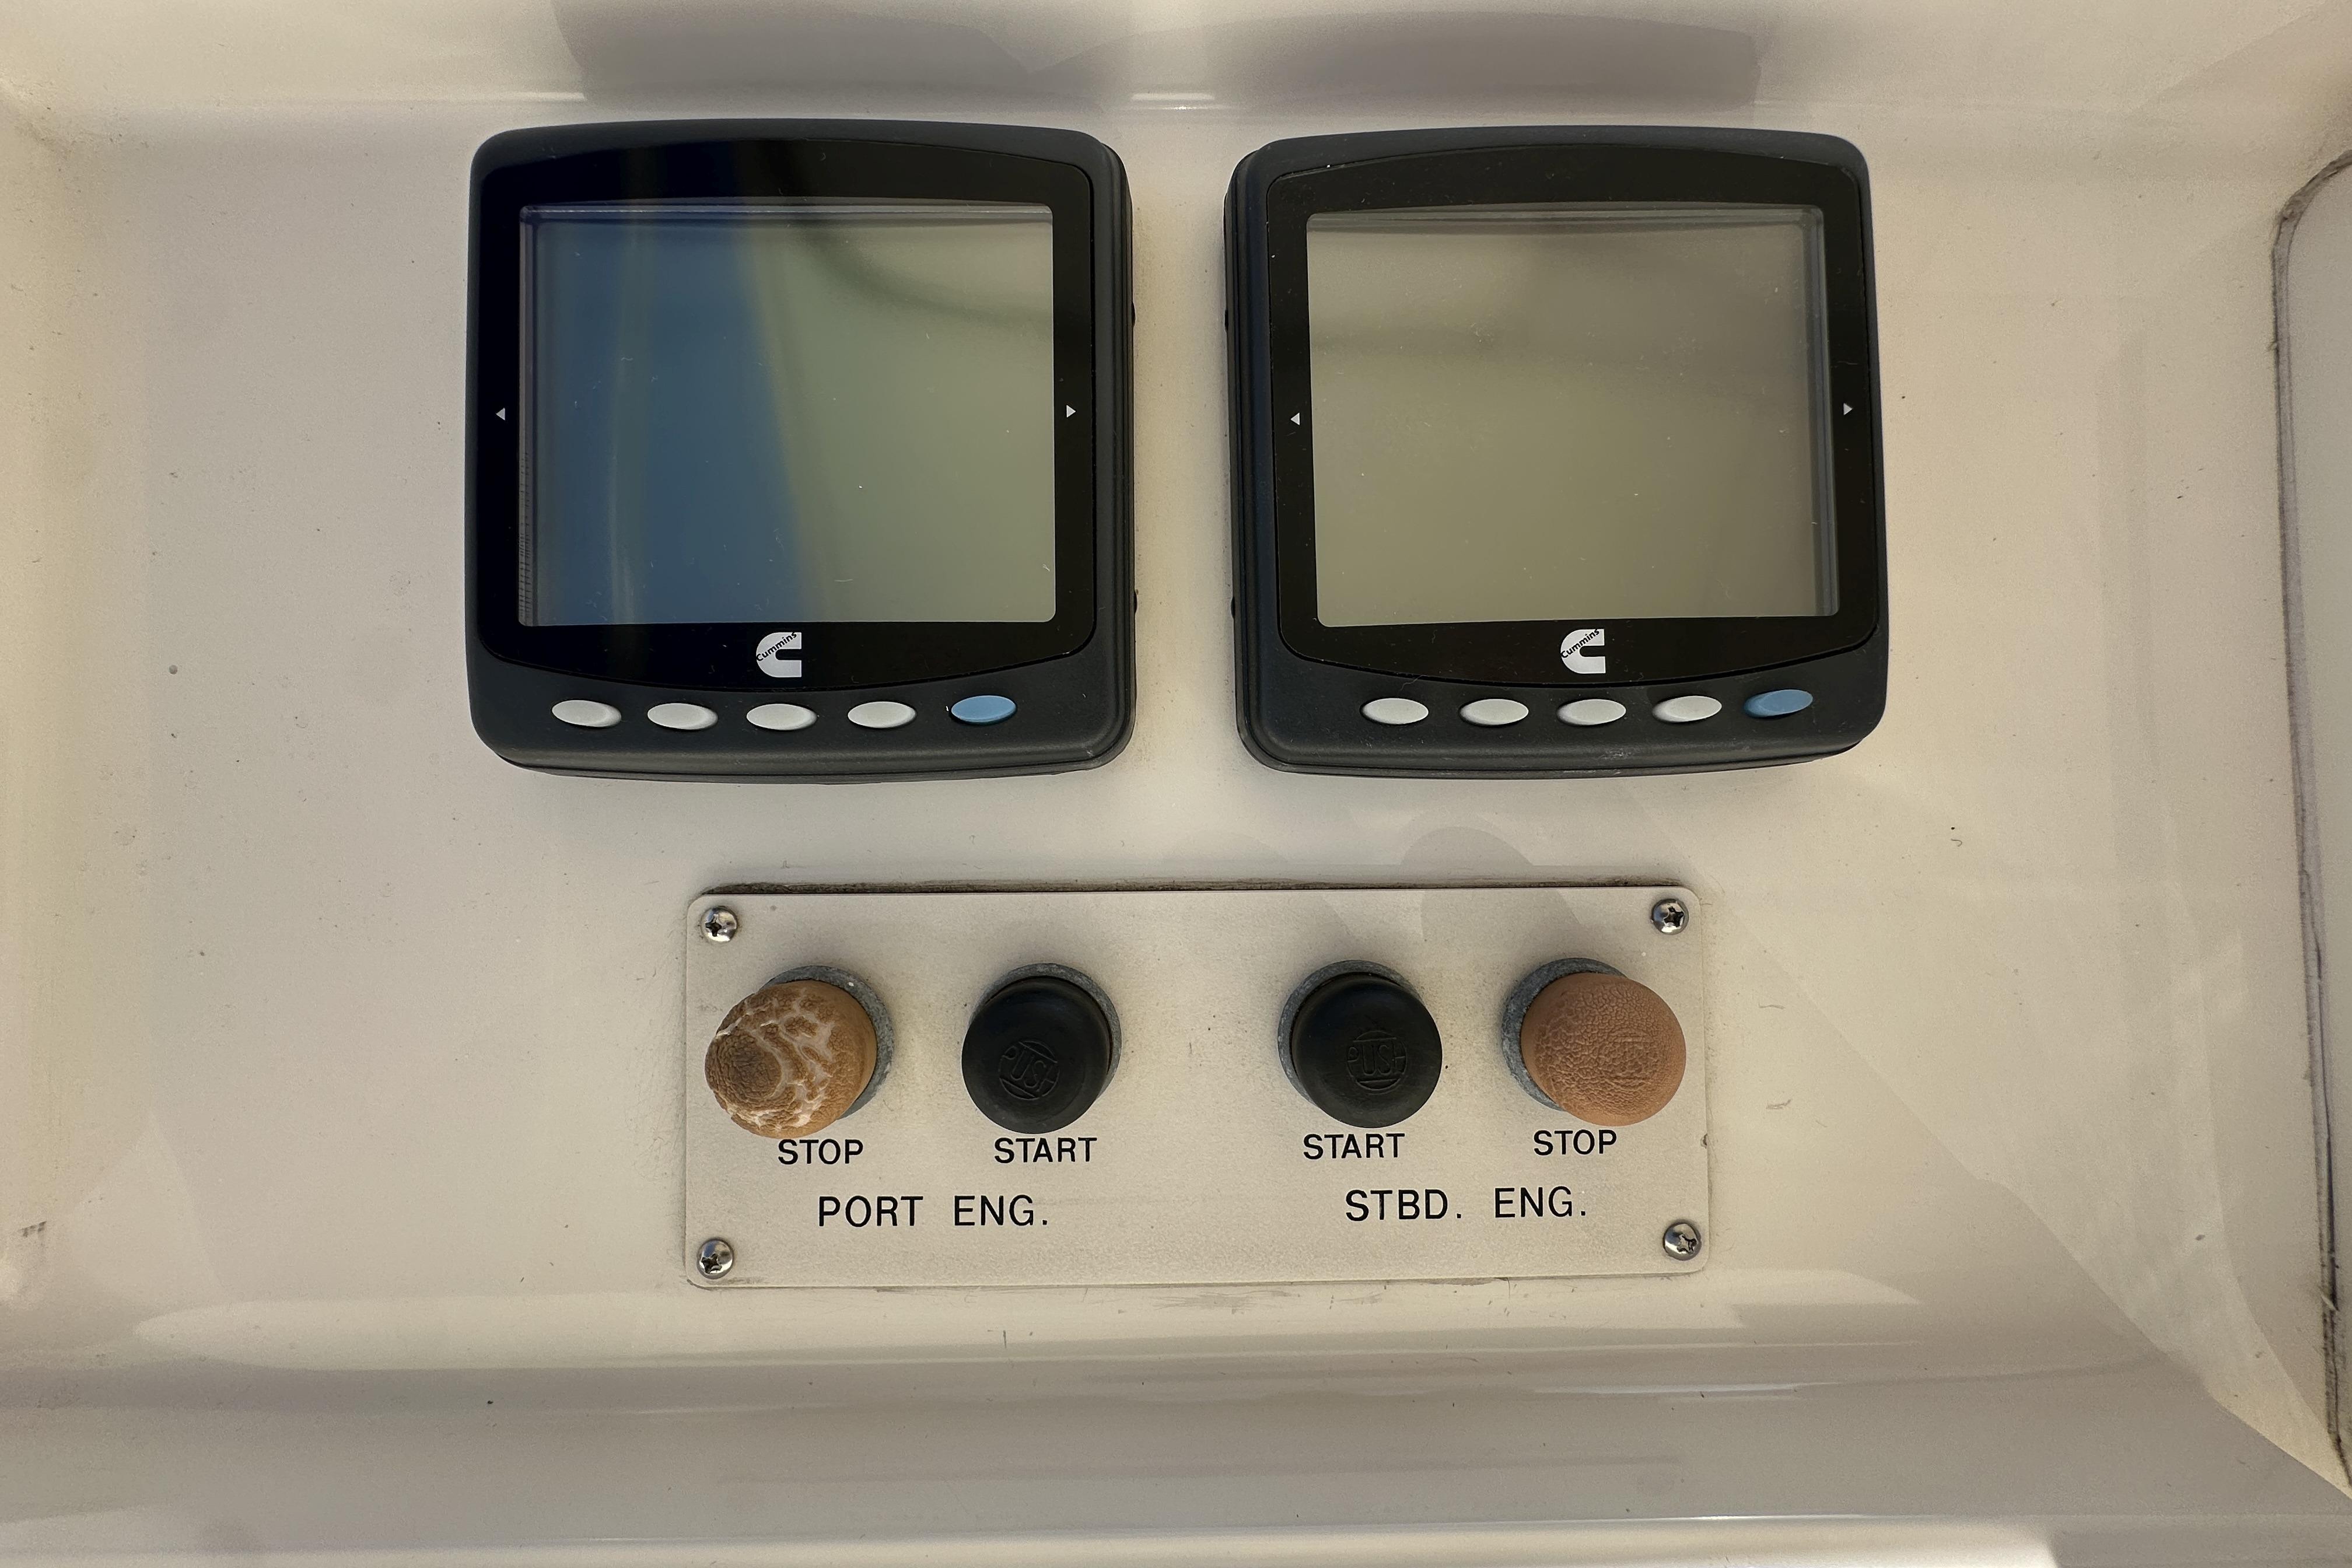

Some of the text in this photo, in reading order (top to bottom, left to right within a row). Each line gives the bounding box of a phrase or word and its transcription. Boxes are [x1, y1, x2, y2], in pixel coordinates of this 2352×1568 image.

[756, 632, 797, 662] Cummins
[1560, 629, 1600, 659] Cummins
[778, 1139, 863, 1165] STOP
[994, 1137, 1097, 1164] START
[1303, 1133, 1405, 1160] START
[1534, 1129, 1617, 1156] STOP
[819, 1194, 1048, 1227] PORT ENG.
[1346, 1185, 1586, 1222] STBD. ENG.
